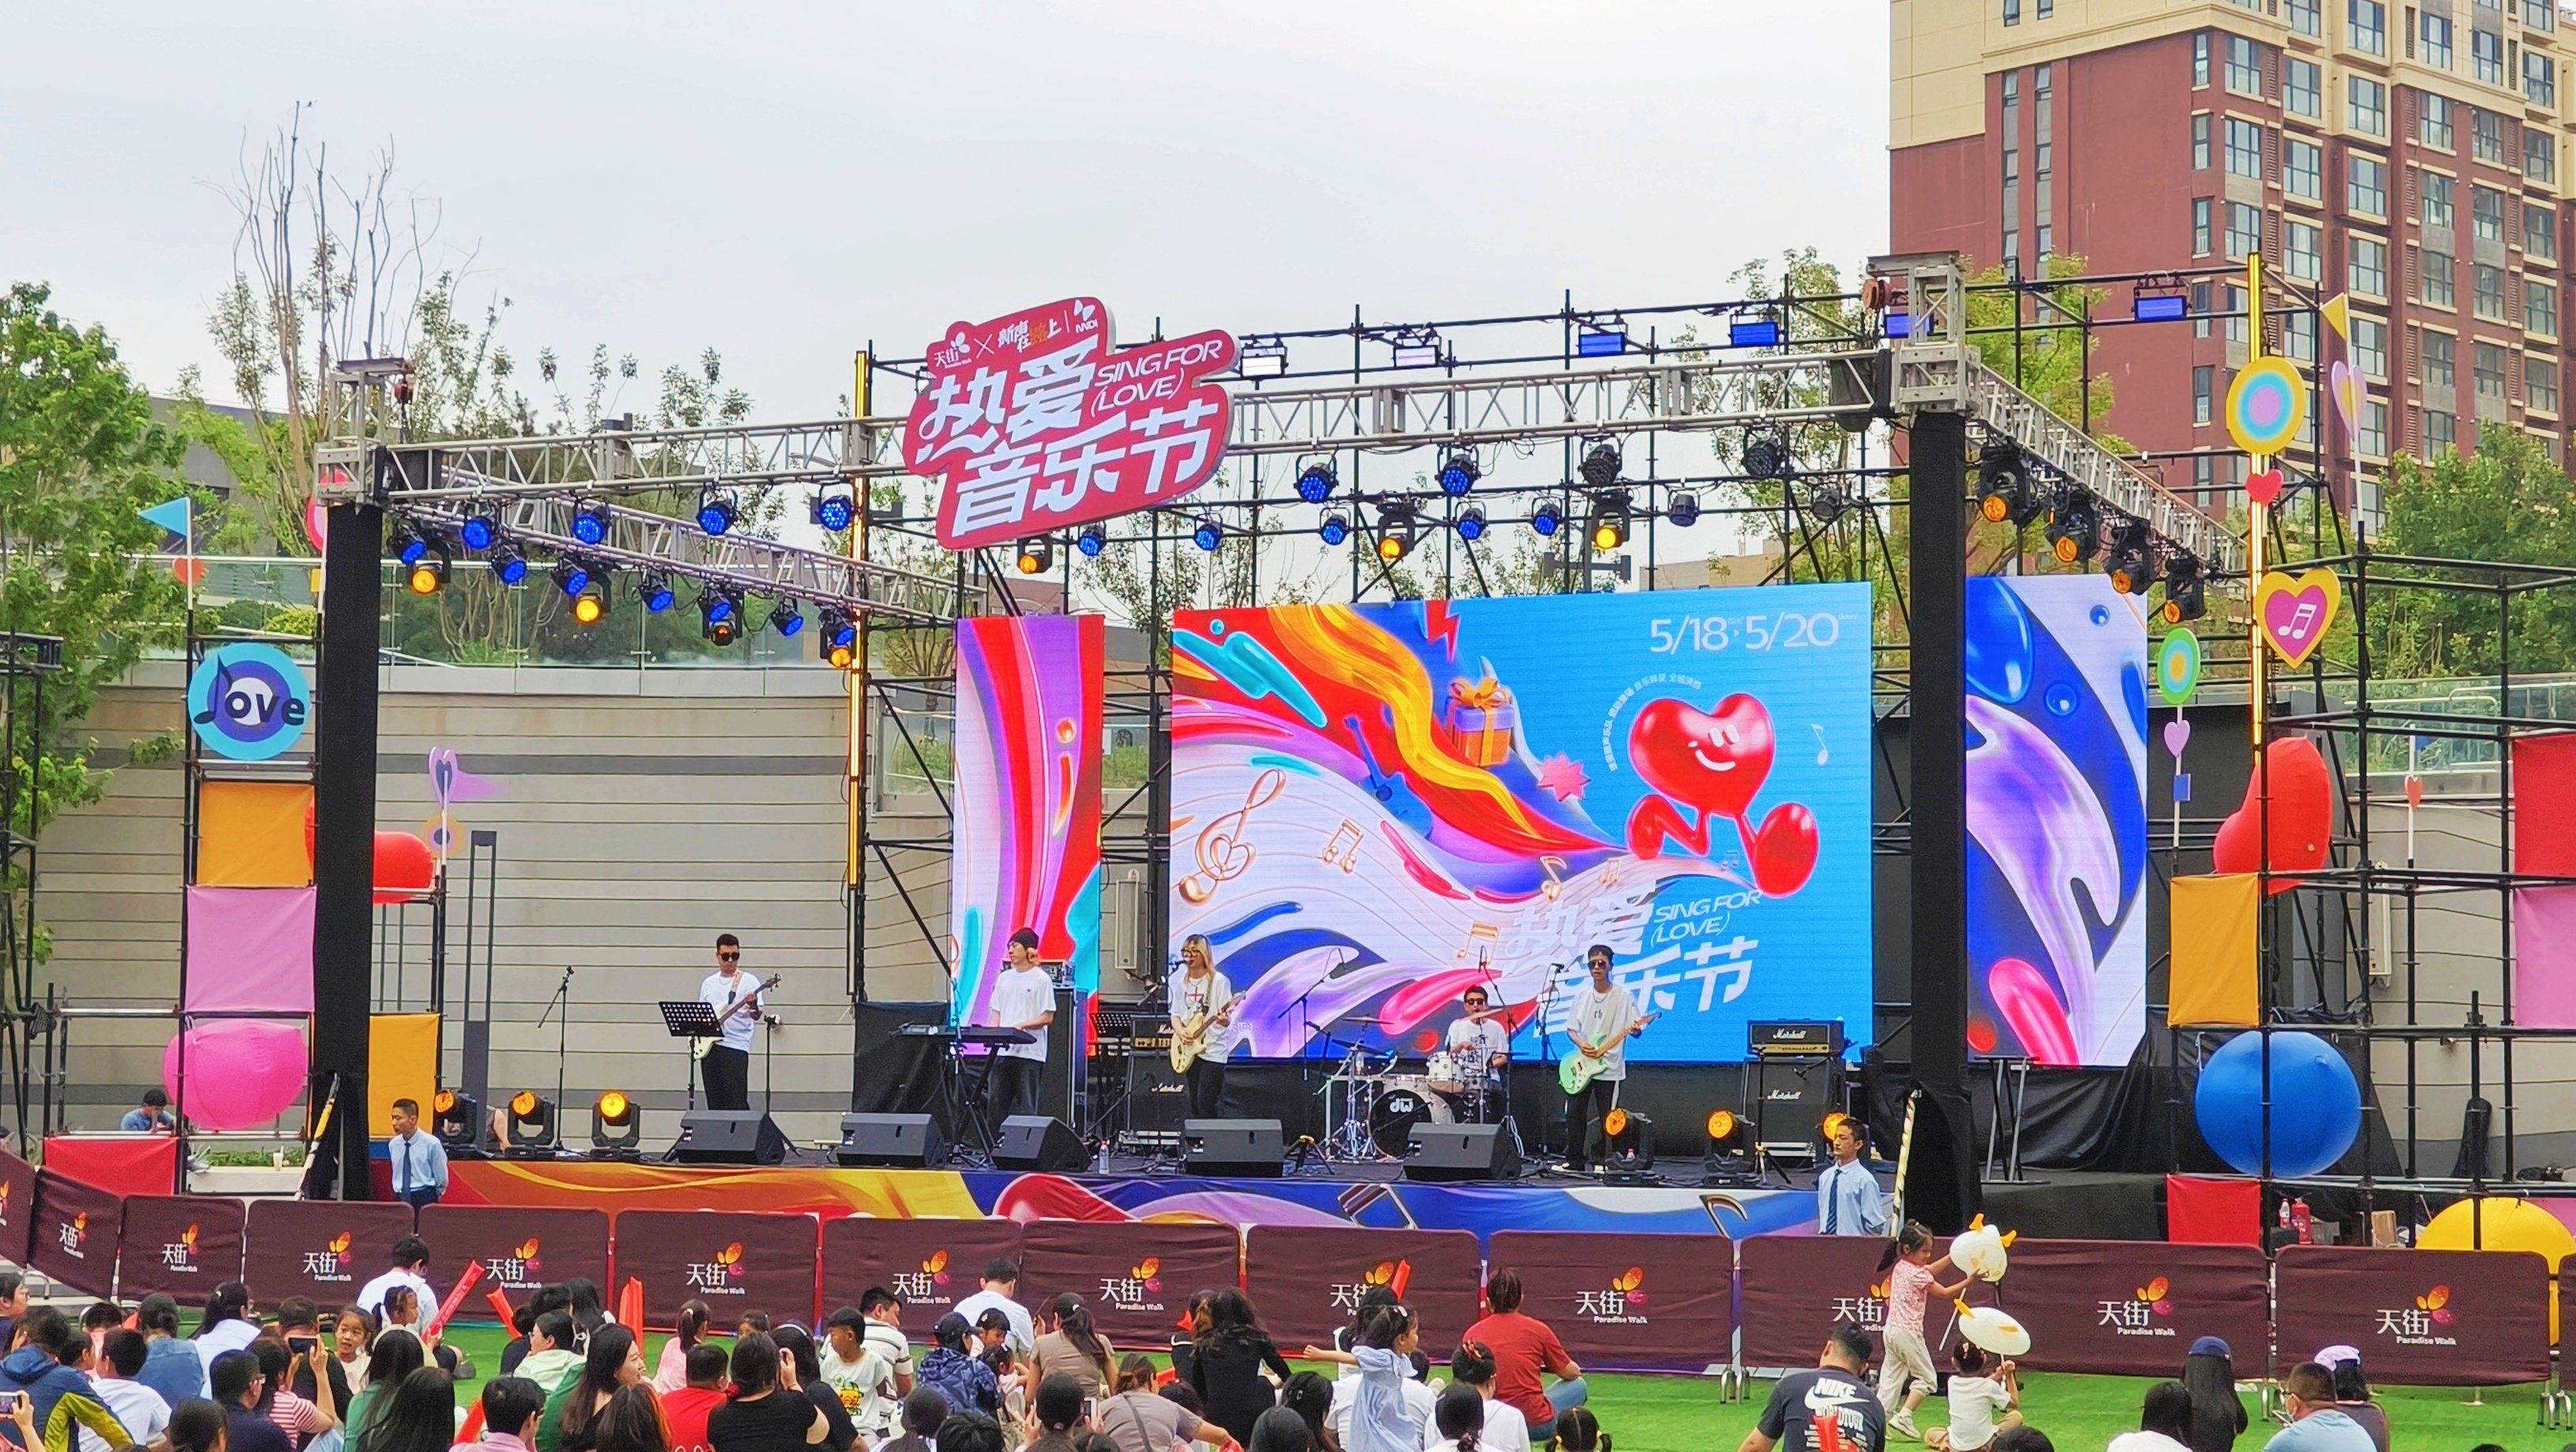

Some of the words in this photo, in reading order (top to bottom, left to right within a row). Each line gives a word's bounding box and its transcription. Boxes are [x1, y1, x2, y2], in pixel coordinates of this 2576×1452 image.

[1094, 353, 1163, 387] SING
[1163, 339, 1223, 370] FOR
[915, 333, 1099, 466] 热爱
[1091, 367, 1185, 417] (LOVE)
[950, 398, 1220, 537] 音乐节
[1653, 898, 1712, 923] SING
[1712, 889, 1764, 913] FOR
[1650, 911, 1731, 948] (LOVE)
[1773, 1027, 1807, 1039] Marshall
[1767, 1089, 1802, 1100] Marshall
[302, 1252, 338, 1274] 天街
[485, 1258, 525, 1281] 天街
[686, 1263, 727, 1286] 天街
[892, 1272, 933, 1297] 天街
[1099, 1278, 1144, 1303] 天街
[1115, 1300, 1145, 1311] Paradise
[1575, 1289, 1625, 1315] 天街
[1831, 1297, 1883, 1323] 天街
[2097, 1300, 2151, 1327] 天街
[1593, 1314, 1627, 1323] Paradise
[1627, 1315, 1648, 1325] Walk
[2117, 1323, 2153, 1336] Paradise
[2154, 1327, 2176, 1337] Walk
[2375, 1308, 2431, 1335] 天街
[2396, 1334, 2434, 1345] Paradise
[2434, 1337, 2457, 1345] Walk
[1814, 1377, 1857, 1398] NIKE
